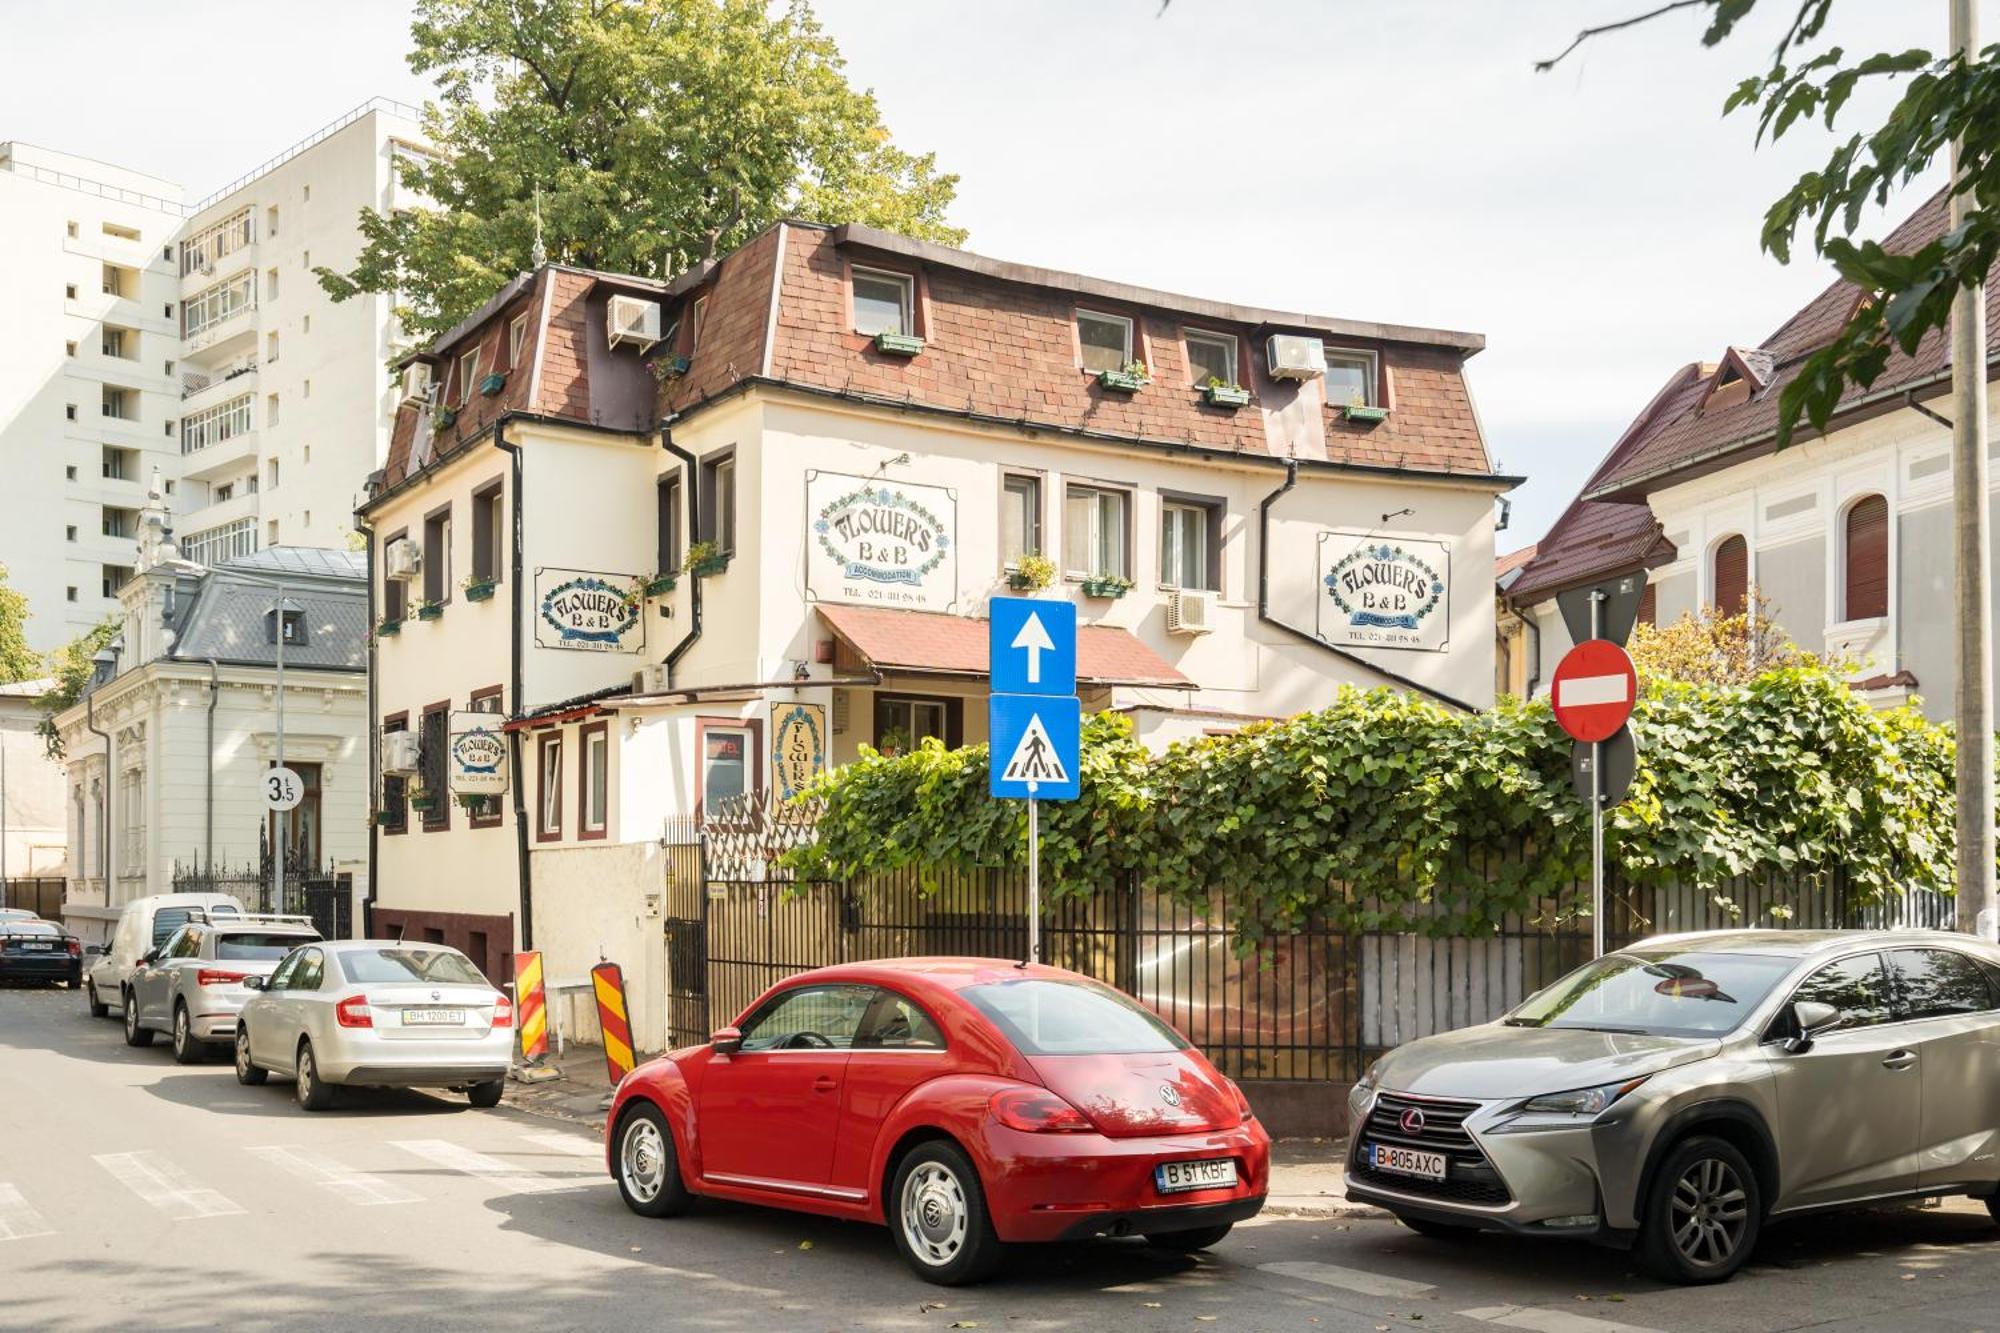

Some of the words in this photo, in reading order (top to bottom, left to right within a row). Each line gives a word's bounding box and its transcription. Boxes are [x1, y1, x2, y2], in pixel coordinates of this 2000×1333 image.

[834, 508, 932, 552] FLOWER'S
[859, 541, 873, 561] B
[877, 547, 889, 562] &
[894, 546, 907, 565] B
[854, 565, 912, 581] ACCOMMODATION
[1342, 563, 1427, 599] FLOWER'S
[554, 593, 626, 622] FLOWER'S
[1363, 591, 1375, 608] B
[1379, 596, 1390, 609] &
[1394, 593, 1406, 610] B
[572, 613, 583, 626] B
[586, 617, 595, 627] &
[599, 615, 609, 628] B
[1167, 1165, 1179, 1184] B
[1182, 1163, 1198, 1182] 51
[1200, 1160, 1227, 1180] KBF
[1377, 1147, 1386, 1165] B
[1390, 1150, 1413, 1170] 805
[1415, 1154, 1442, 1174] AXC
